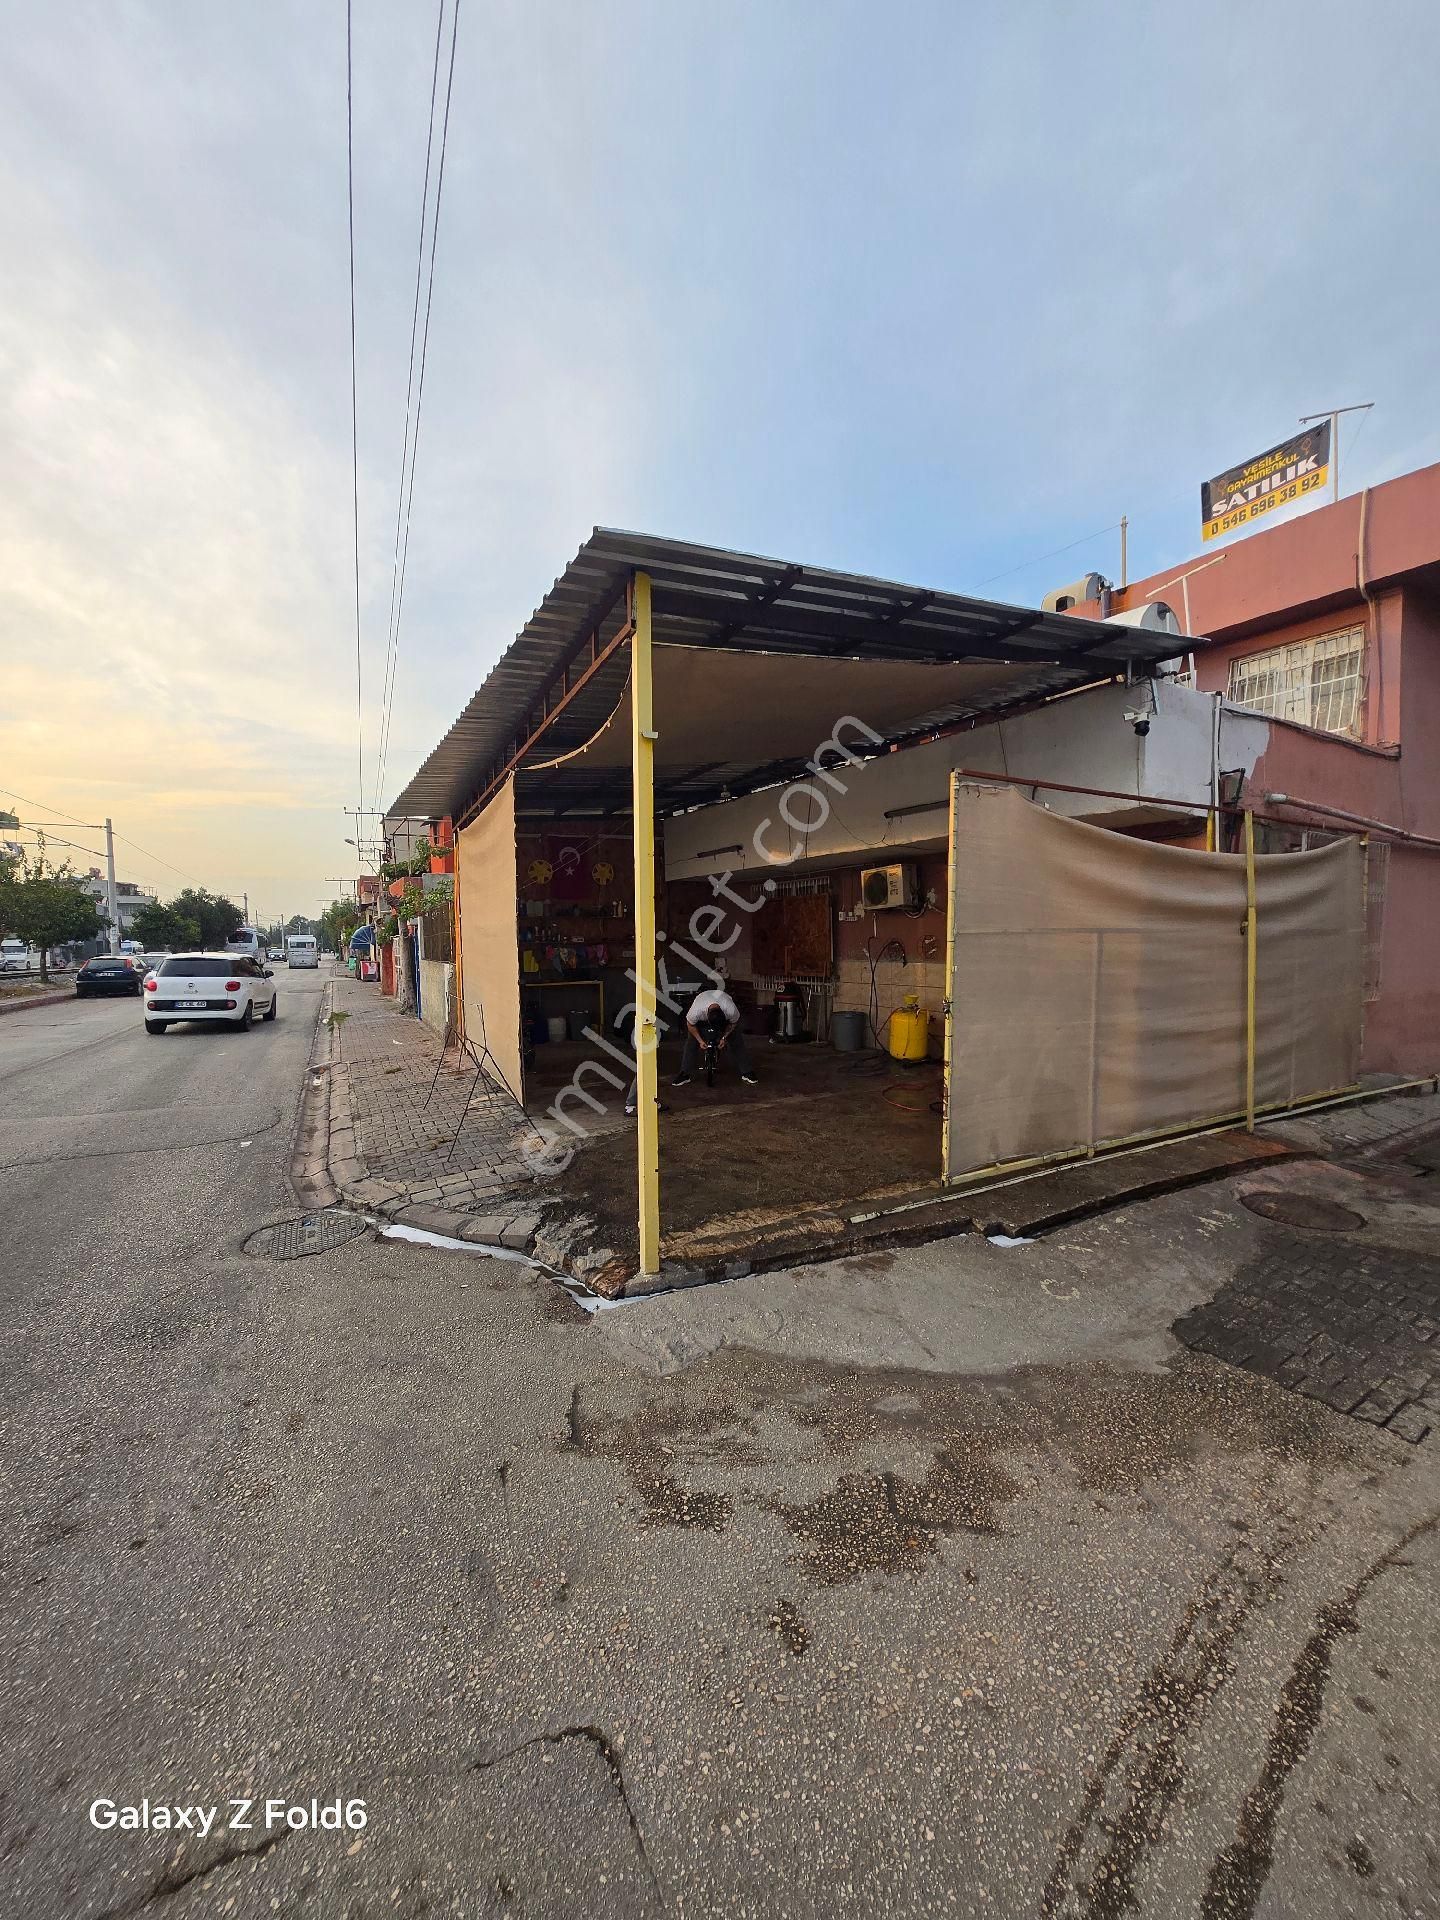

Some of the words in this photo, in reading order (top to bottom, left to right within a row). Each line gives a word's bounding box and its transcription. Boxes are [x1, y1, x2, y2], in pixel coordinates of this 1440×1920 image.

[1211, 453, 1319, 517] SATILIK
[1211, 523, 1219, 535] 0
[1222, 510, 1247, 530] 546
[1250, 495, 1275, 516] 696
[1280, 485, 1297, 502] 38
[1301, 473, 1320, 492] 92
